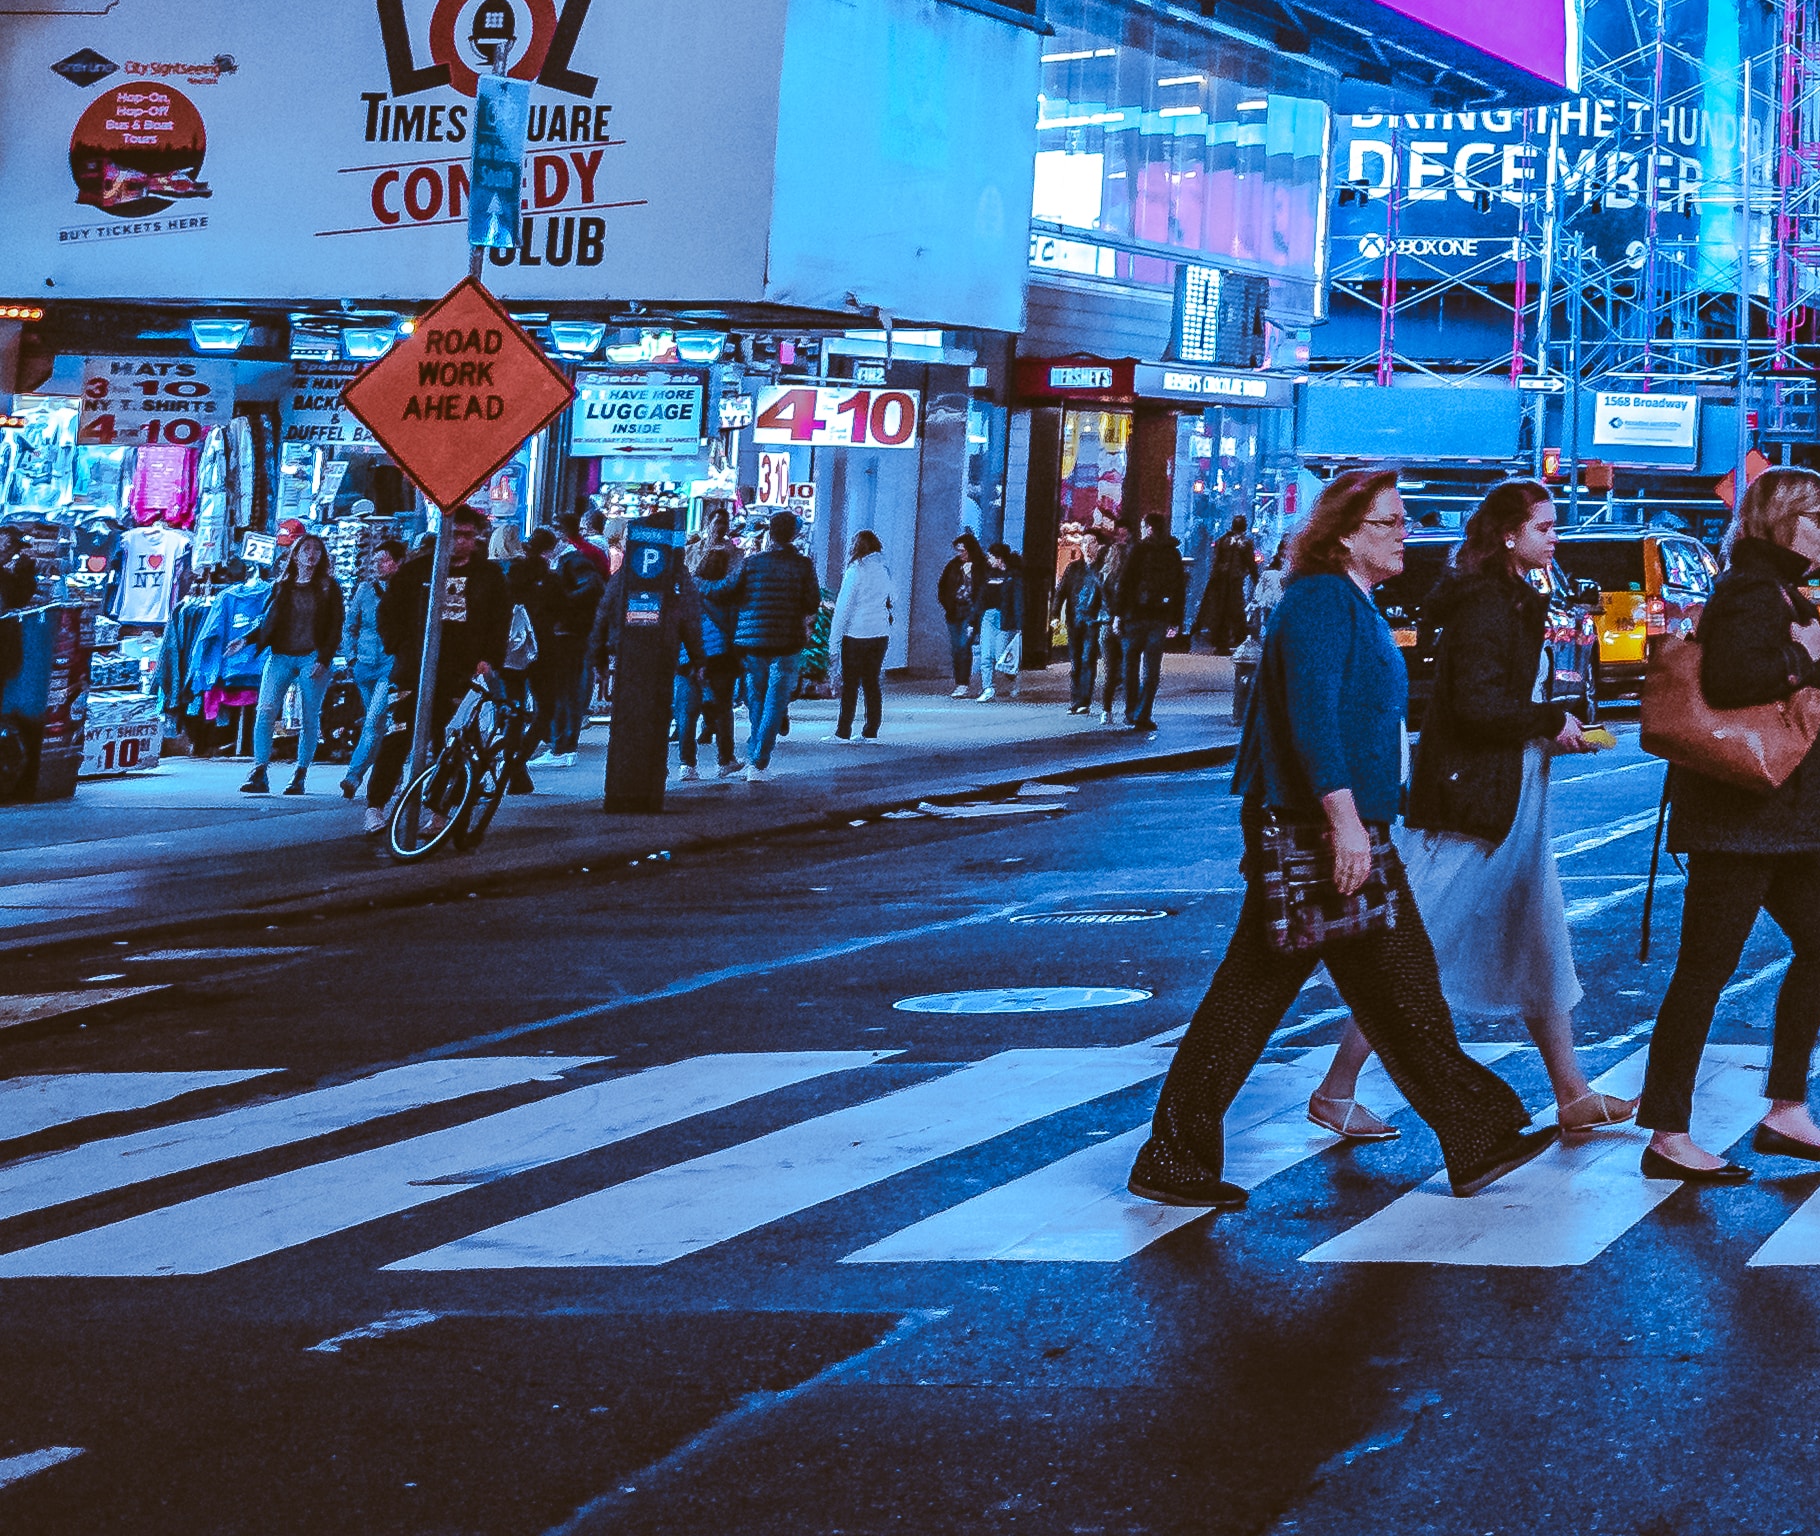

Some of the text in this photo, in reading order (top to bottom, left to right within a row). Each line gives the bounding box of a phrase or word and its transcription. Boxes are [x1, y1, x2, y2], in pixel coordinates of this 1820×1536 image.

[527, 105, 613, 143] UARE
[123, 132, 159, 145] Tours
[1348, 139, 1703, 214] DECEMBER
[59, 216, 210, 242] BUY TICKETS HERE
[425, 328, 503, 355] ROAD
[110, 362, 197, 377] HATS
[418, 362, 495, 387] WORK
[136, 380, 212, 398] 10
[609, 389, 649, 400] HAVE
[142, 398, 217, 413] SHIRTS
[402, 395, 505, 421] AHEAD
[586, 403, 694, 420] LUGGAGE
[1604, 396, 1688, 413] 1568 Broadway
[756, 389, 827, 442] 4
[836, 389, 915, 445] 10
[85, 418, 202, 445] 4 10
[287, 424, 346, 442] DUFFEL
[612, 423, 662, 434] INSIDE
[760, 454, 775, 505] 3
[641, 548, 659, 574] P
[133, 571, 165, 589] NY
